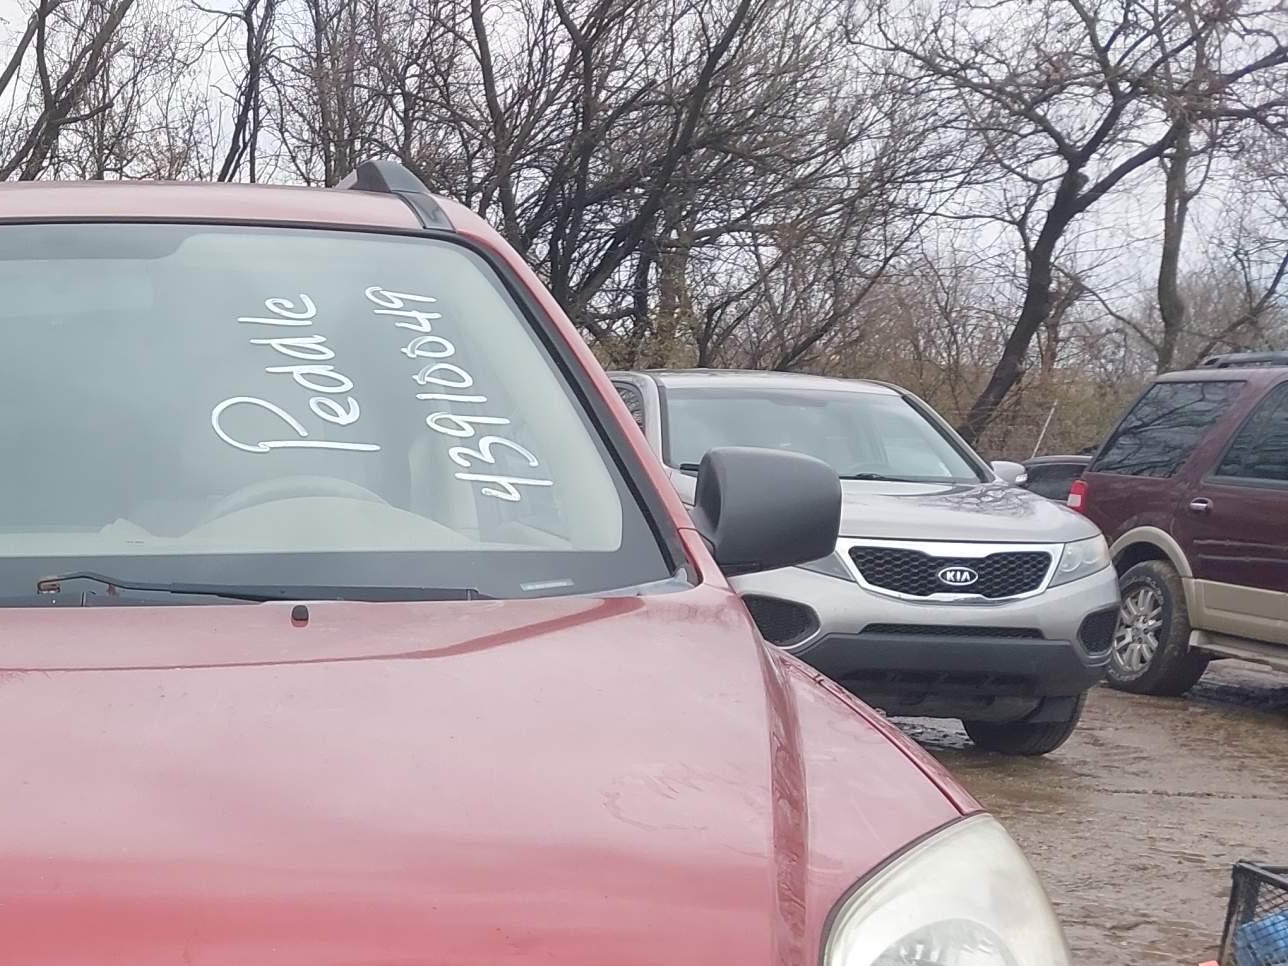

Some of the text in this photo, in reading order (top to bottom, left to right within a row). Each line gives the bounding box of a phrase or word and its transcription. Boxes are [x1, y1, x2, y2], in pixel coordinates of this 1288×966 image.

[212, 294, 381, 453] Peddle
[365, 286, 554, 502] 43910049
[946, 571, 971, 582] KIA
